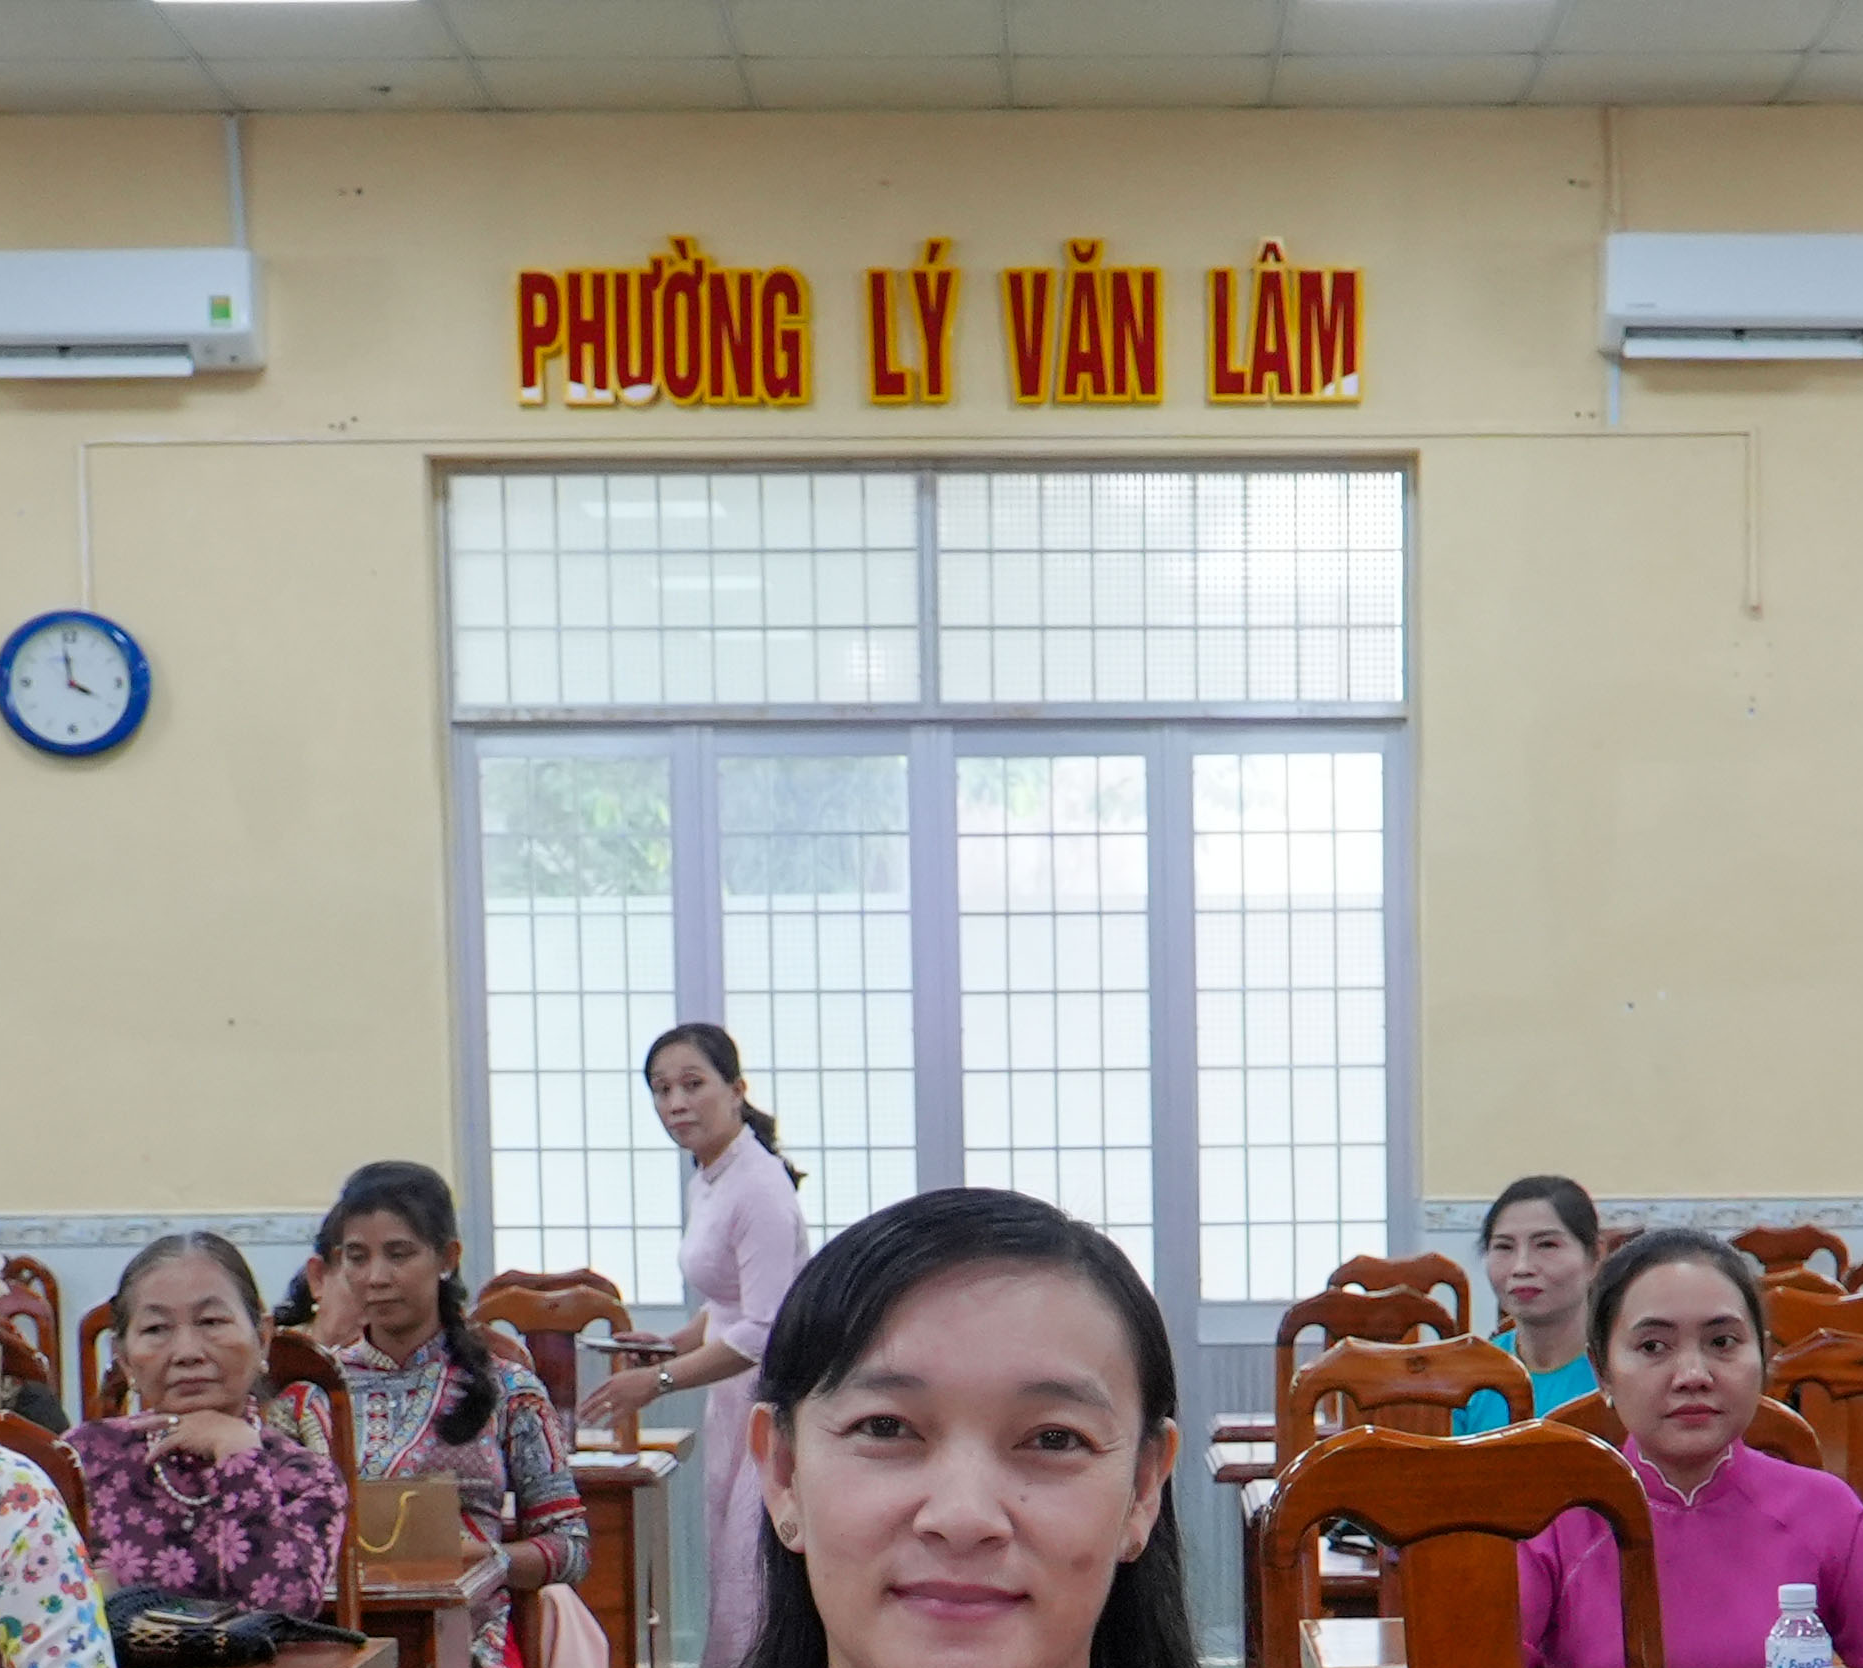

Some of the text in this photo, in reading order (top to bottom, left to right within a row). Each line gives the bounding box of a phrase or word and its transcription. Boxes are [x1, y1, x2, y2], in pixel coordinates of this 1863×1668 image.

[517, 236, 1363, 406] PHƯỜNG LÝ VĂN LÂM
